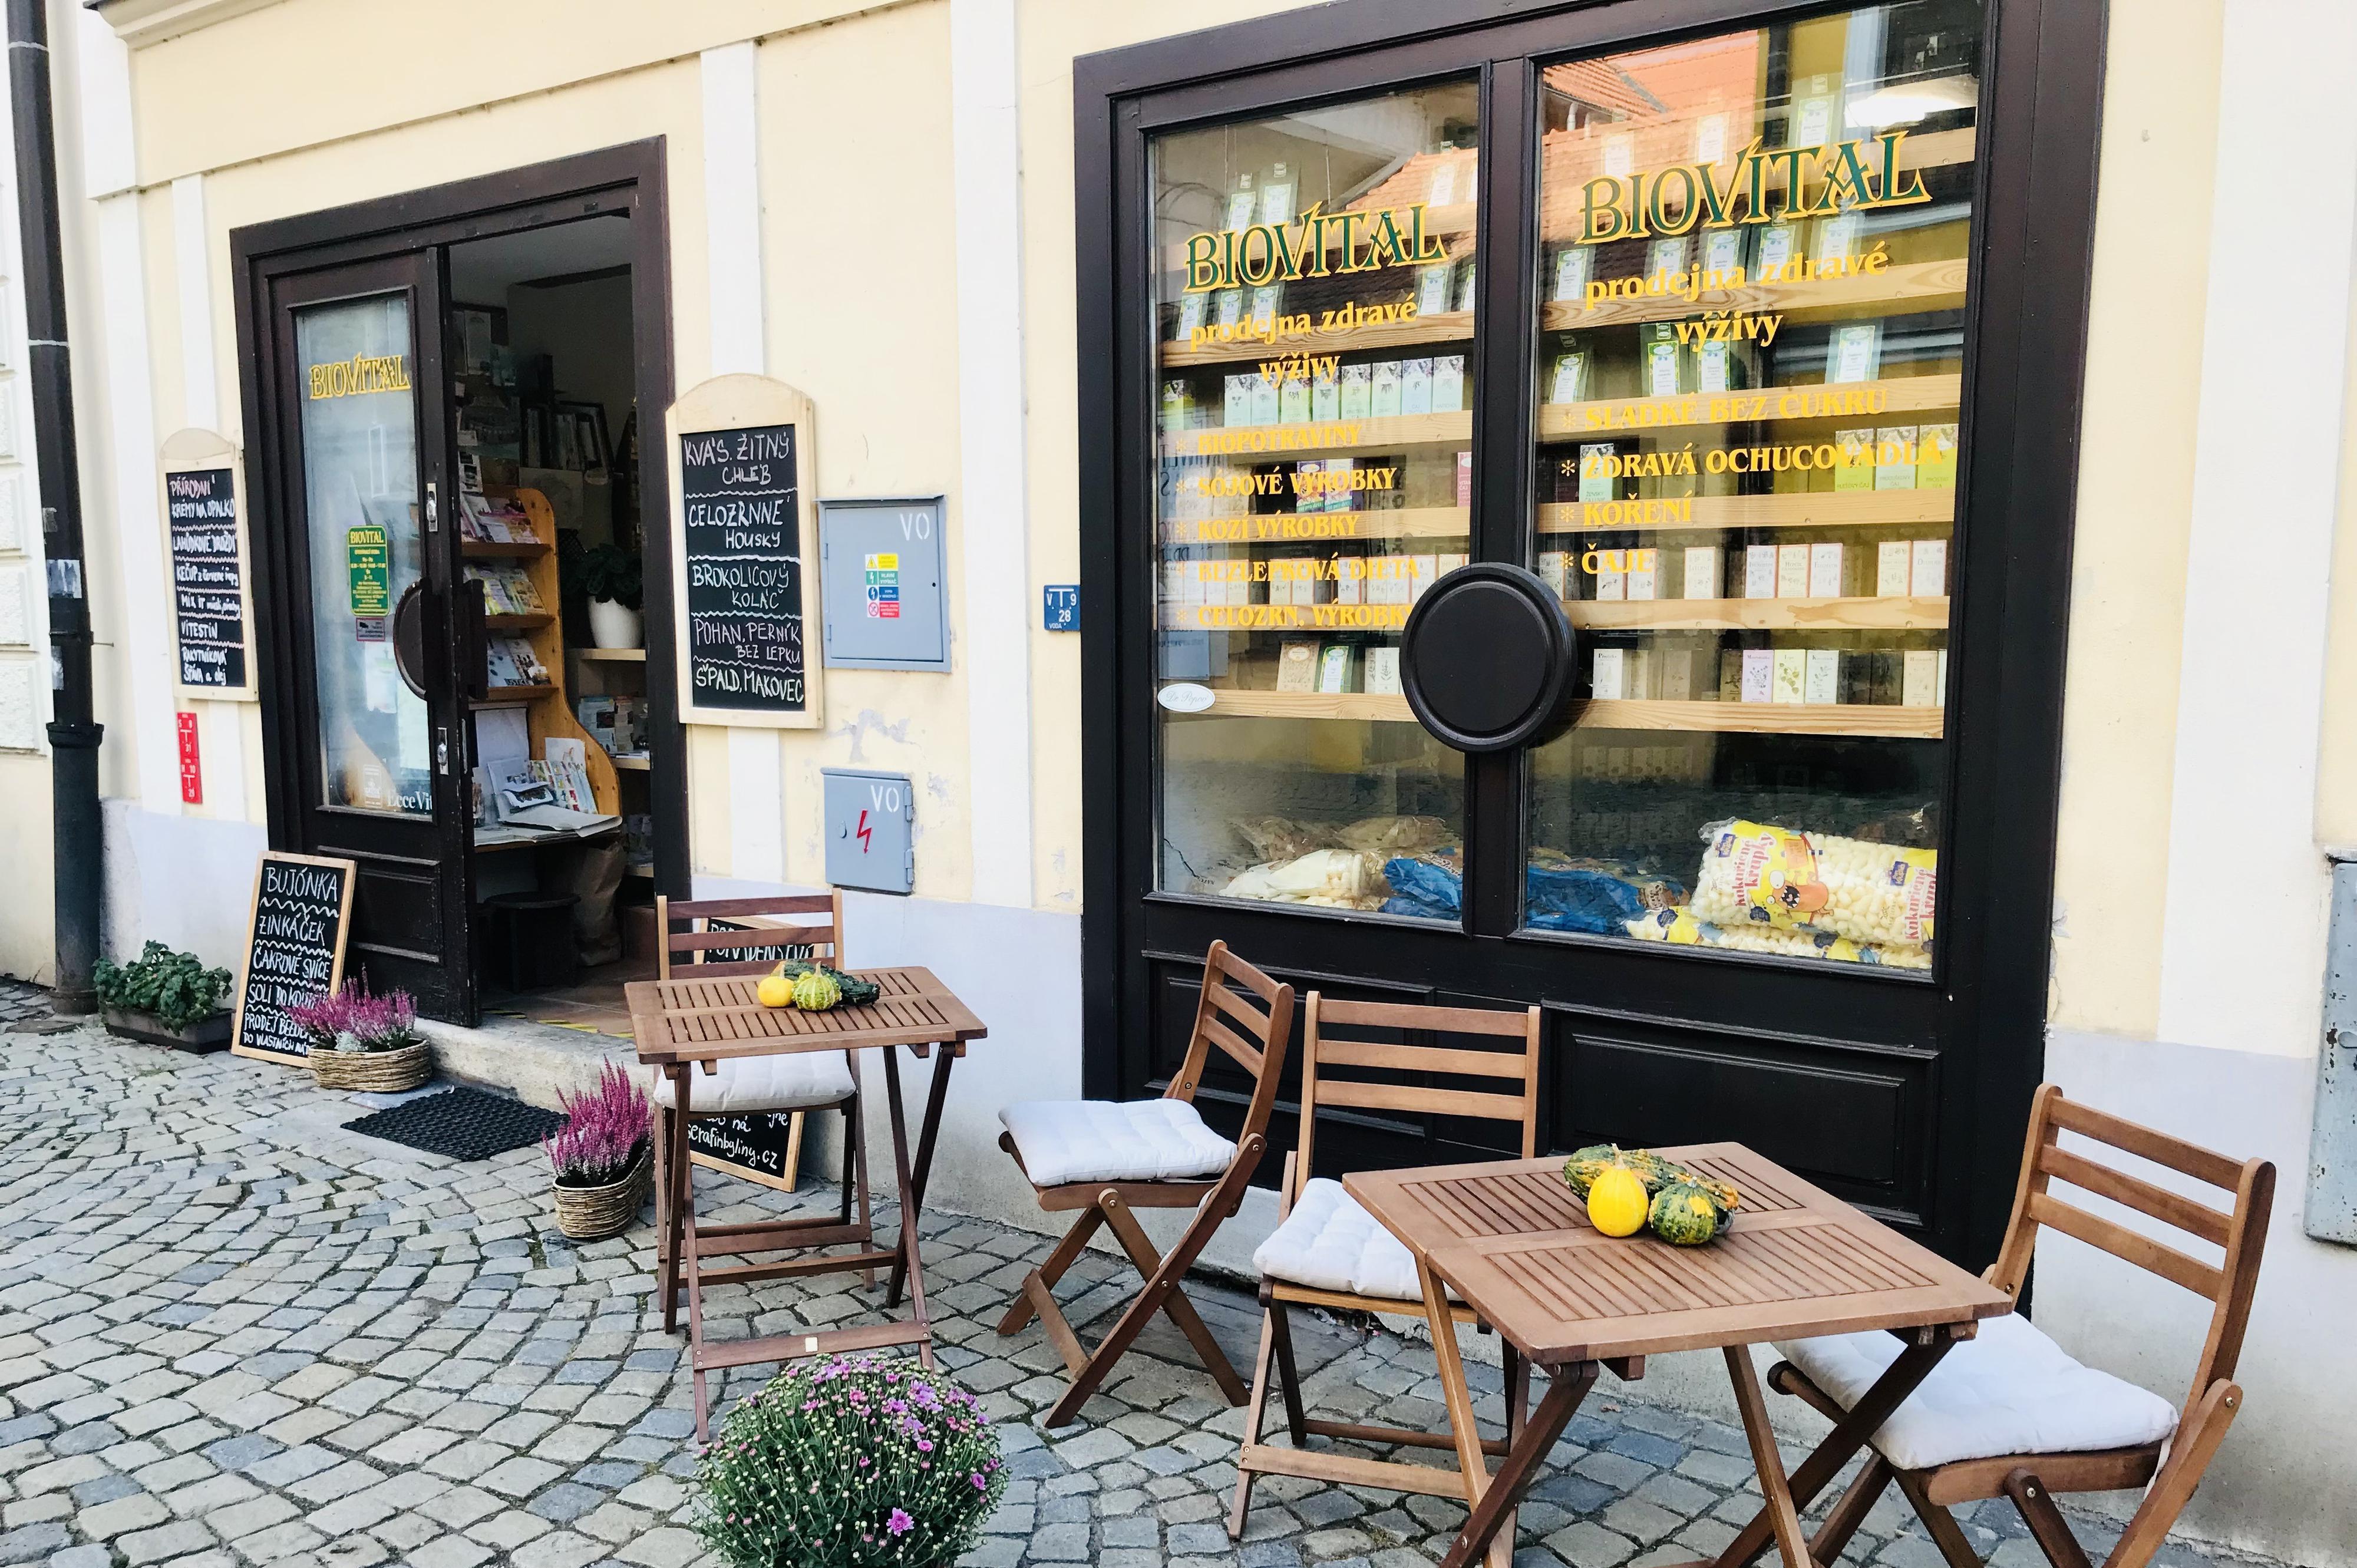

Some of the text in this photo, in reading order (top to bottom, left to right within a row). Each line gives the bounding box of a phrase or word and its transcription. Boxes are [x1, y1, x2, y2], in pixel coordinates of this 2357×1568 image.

[1585, 240, 1888, 310] prodejna zdravé
[1190, 293, 1418, 352] prodejna zdravé
[1676, 311, 1783, 353] výživy
[1259, 352, 1341, 389] výživy
[1584, 389, 1887, 430] SLADKÉ BEZ CUKRU
[737, 431, 790, 463] ŽITNÝ
[1197, 425, 1362, 455] BIOPOTRAVINY
[722, 461, 771, 485] CHLÉB
[1584, 439, 1943, 480] ZDRAVÁ OCHUCOVADLA
[1197, 466, 1283, 499] SÓJOVÉ
[688, 496, 791, 527] CELOZRNNÉ
[1583, 492, 1692, 526] KOŘENÍ
[900, 511, 929, 541] VO
[1197, 510, 1360, 540] KOZÍ VÝROBKY
[1198, 552, 1420, 582] BEZLEPKOVÁ DIETA
[1582, 543, 1653, 575] ČAJE
[692, 563, 789, 588] BROKOLICOVÝ
[732, 589, 783, 609] KOLÁČ
[1070, 593, 1077, 606] 9
[1058, 609, 1071, 622] 28
[1198, 605, 1305, 626] CELOZRN.
[745, 622, 801, 645] PERNÍK
[735, 645, 800, 664] BEZ LEPKU
[744, 669, 804, 703] MAKOVEC
[870, 785, 899, 813] VO
[266, 866, 338, 902] BUJÓNKA
[253, 947, 330, 981] ČAKROVÉ SVÍCE
[244, 1012, 278, 1033] PRODEJ
[256, 1033, 294, 1050] VLASTNÍCH
